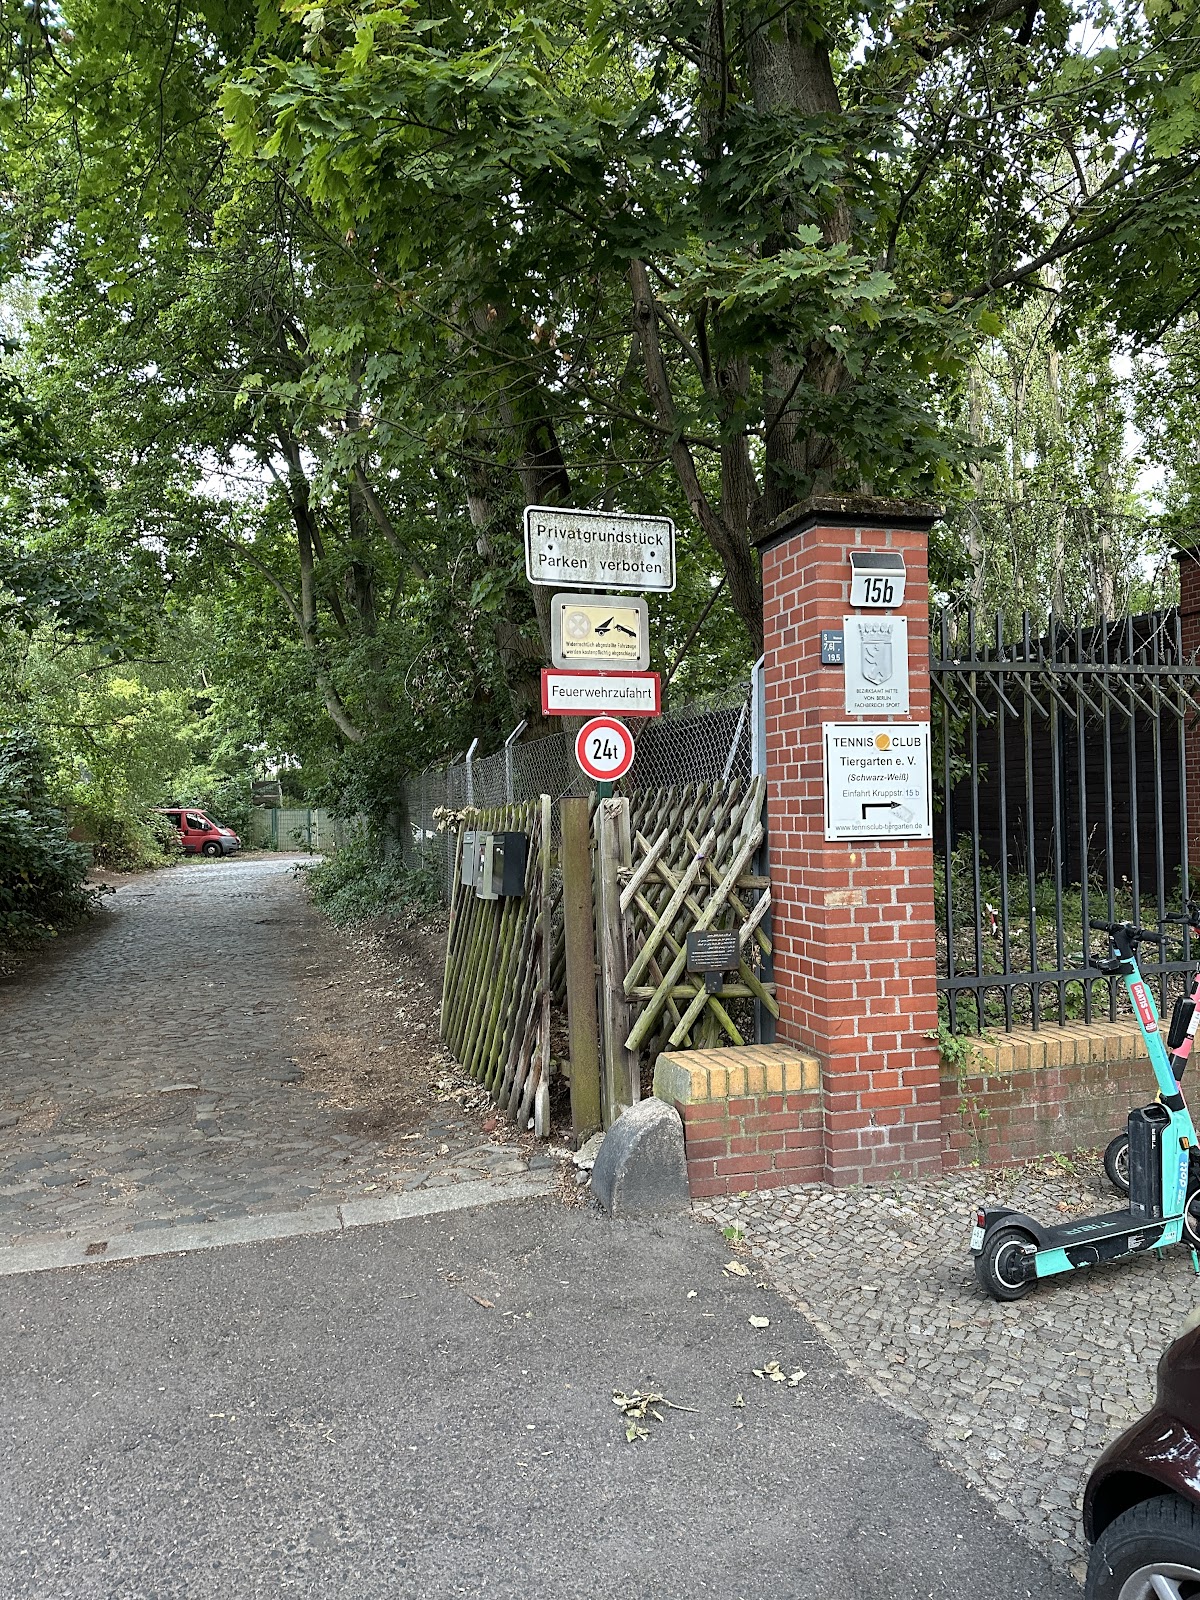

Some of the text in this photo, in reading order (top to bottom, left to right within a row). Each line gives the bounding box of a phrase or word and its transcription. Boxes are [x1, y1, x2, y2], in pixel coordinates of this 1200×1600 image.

[537, 524, 663, 546] Privatgrundstück
[538, 553, 662, 574] Parken verboten
[864, 577, 894, 604] 15b
[827, 653, 841, 662] 19,5
[552, 685, 652, 699] Feuerwehrzufahrt
[833, 737, 921, 747] TENNIS CLUB
[839, 755, 917, 769] Tiergarten e. V.
[847, 773, 909, 783] (Schwarz-Weiß)
[842, 789, 920, 799] Einfahrt Kruppstr. 15 b
[1133, 984, 1149, 1009] GRATIS
[1178, 1161, 1188, 1187] dott
